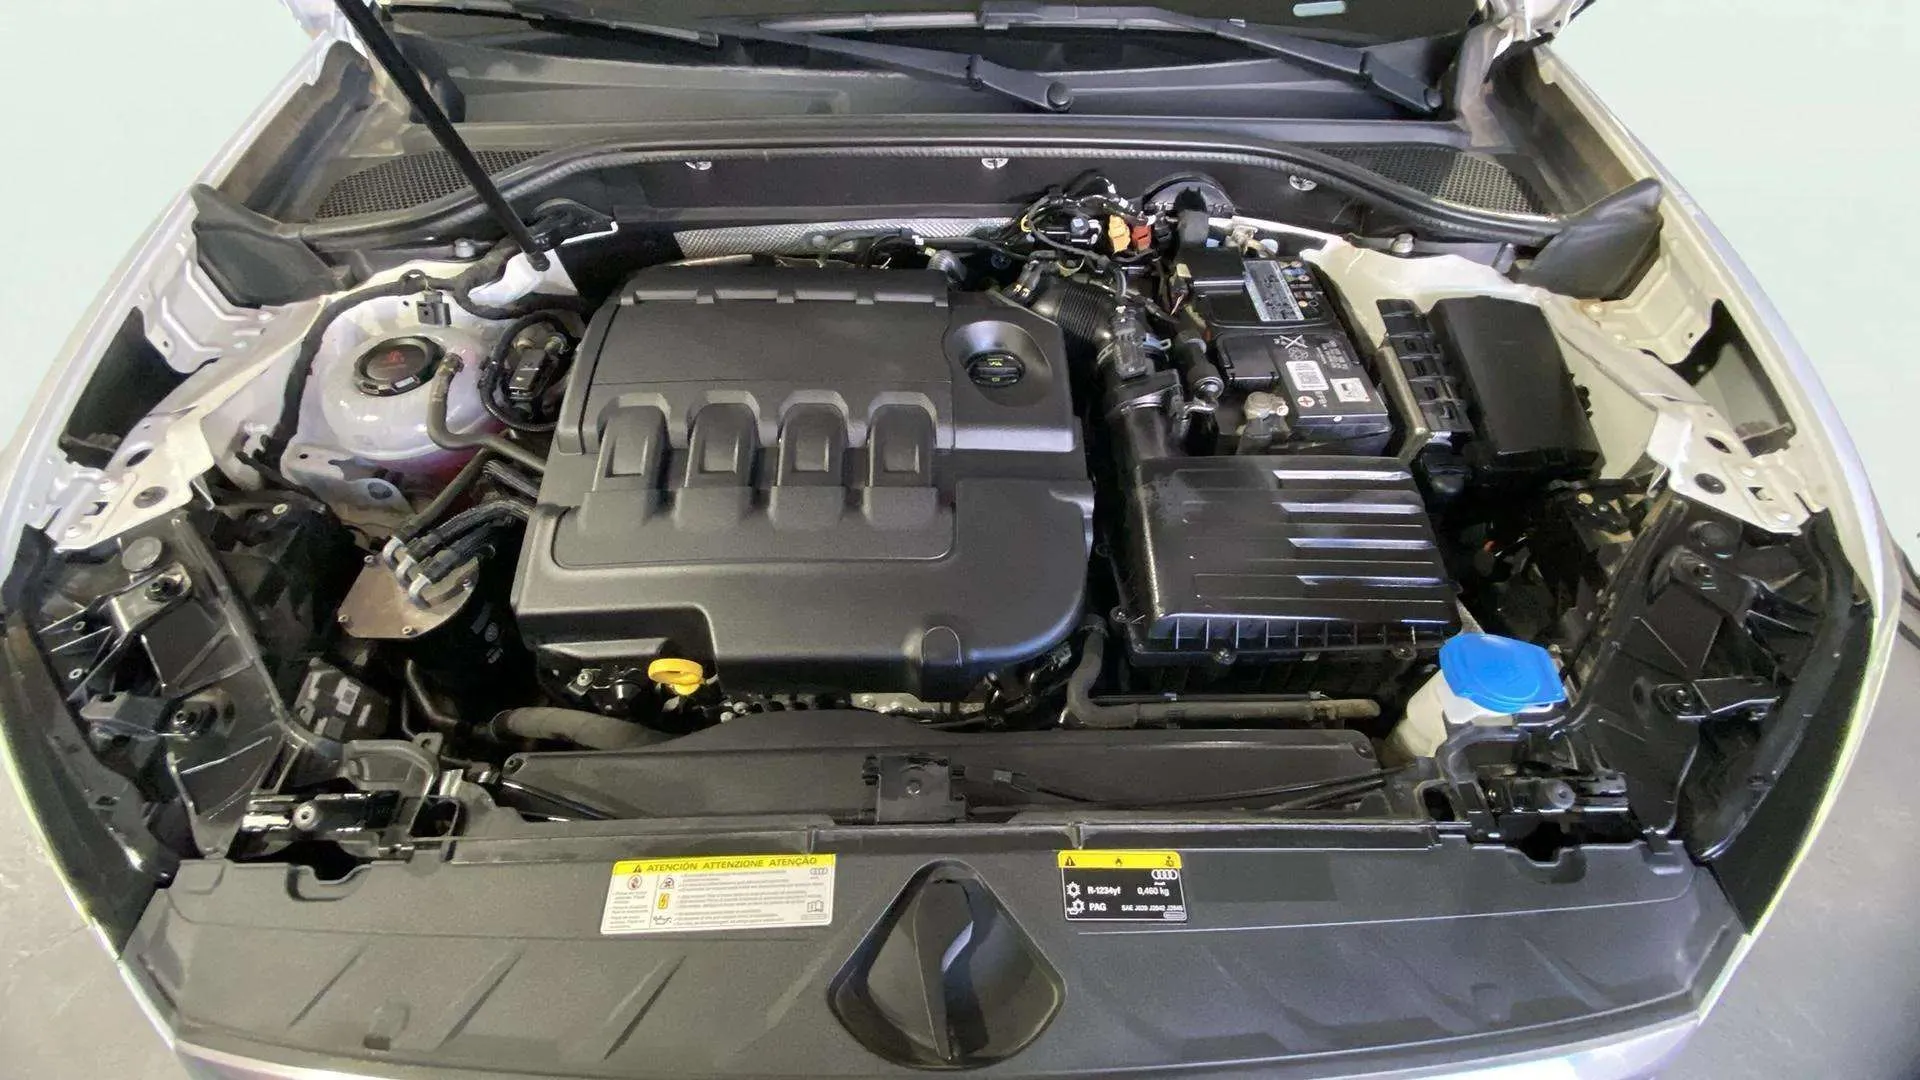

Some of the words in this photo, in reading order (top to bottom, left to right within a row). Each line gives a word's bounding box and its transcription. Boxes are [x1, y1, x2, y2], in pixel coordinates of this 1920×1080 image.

[646, 862, 698, 873] ATENCIÓN
[702, 859, 764, 870] ATTENZIONE
[768, 857, 818, 868] ATENÇÃO
[1087, 886, 1121, 896] R-1234yf
[1160, 886, 1170, 897] kg
[1089, 902, 1107, 911] PAG
